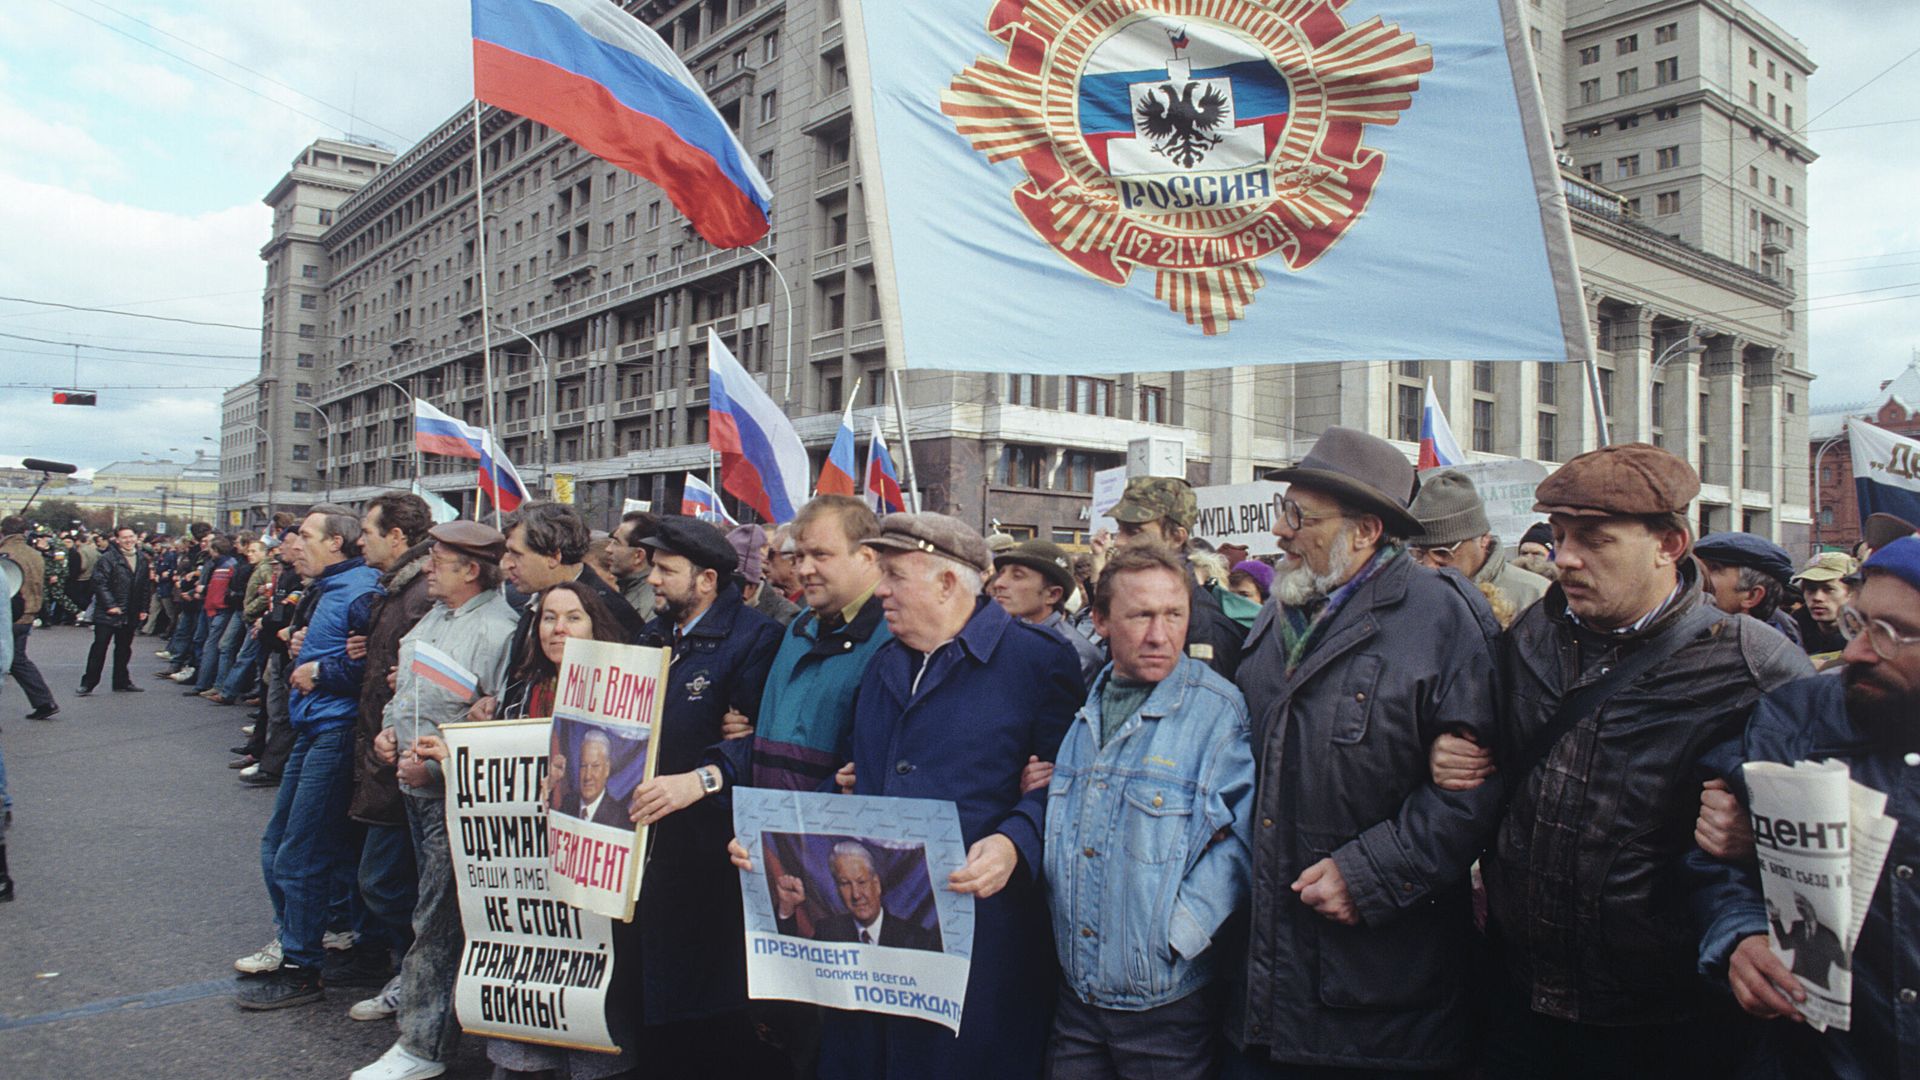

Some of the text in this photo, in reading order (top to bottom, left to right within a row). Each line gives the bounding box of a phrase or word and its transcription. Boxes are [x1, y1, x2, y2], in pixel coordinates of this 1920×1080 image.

[1120, 169, 1270, 210] РОССИЯ
[563, 663, 657, 724] МЫ С ВАМИ
[467, 863, 509, 889] ВАШИ
[484, 895, 583, 940] НЕ СТОЯТ
[464, 941, 608, 989] ГРАЖДАНСКОЙ
[754, 937, 860, 966] ПРЕЗИДЕНТ
[815, 967, 917, 986] ДОЛЖЕН ВСЕГДА
[481, 982, 568, 1031] ВОЙНЫ!
